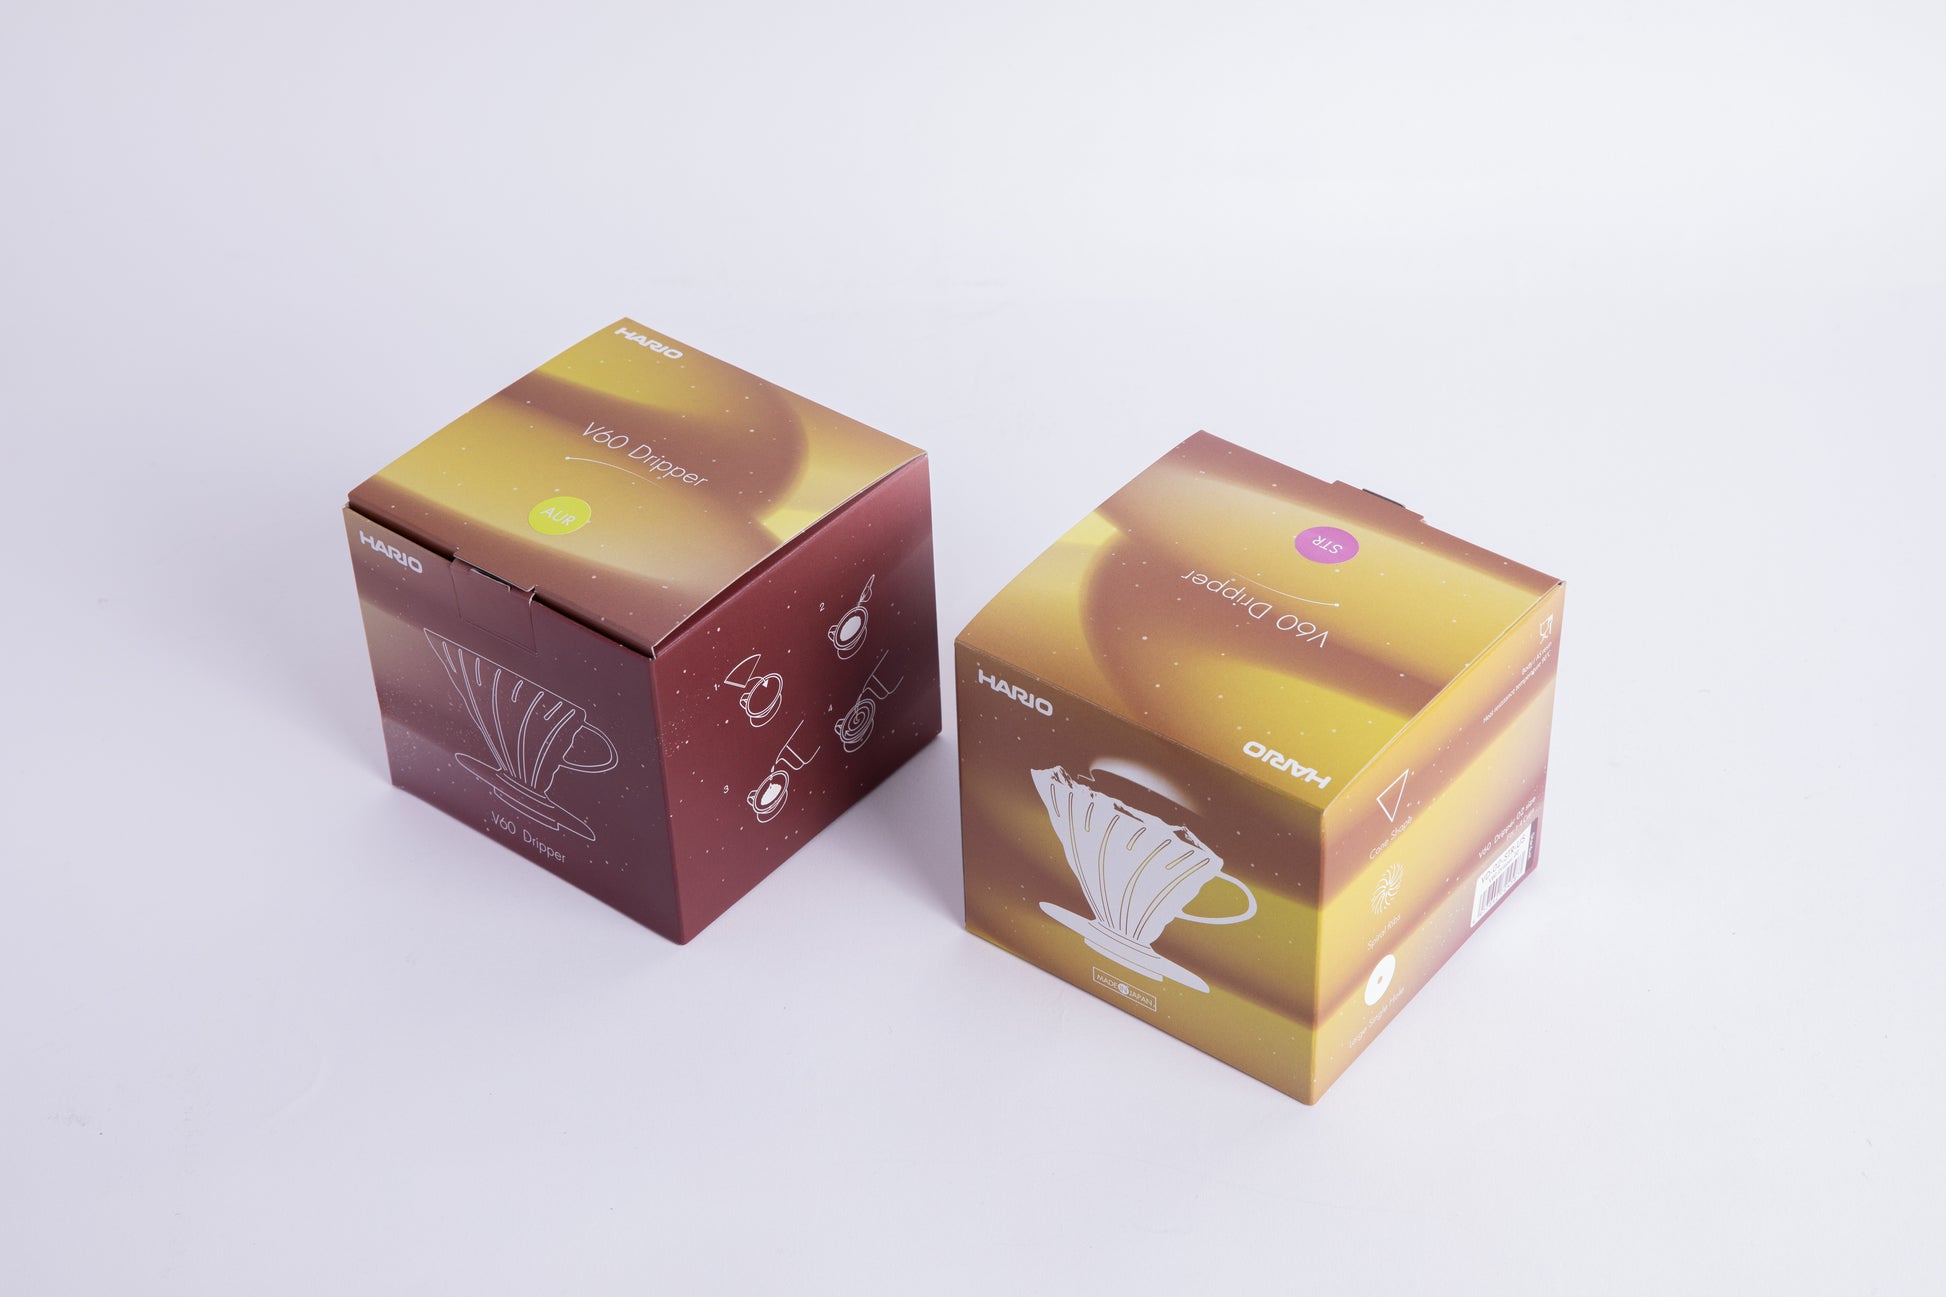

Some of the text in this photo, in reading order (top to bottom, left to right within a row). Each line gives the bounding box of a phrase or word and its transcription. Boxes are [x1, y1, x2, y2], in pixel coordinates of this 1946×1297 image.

[614, 327, 683, 359] HARIO
[582, 421, 709, 487] V60 Dripper
[540, 507, 577, 527] AUR
[359, 529, 423, 574] HARIO
[1312, 535, 1343, 554] STR
[1180, 570, 1329, 648] V60 Dripper
[978, 669, 1053, 717] HARIO
[1243, 741, 1332, 789] HARIO
[491, 810, 566, 863] V60 Dripper
[1369, 839, 1389, 860] Cone
[1096, 974, 1118, 989] MADE
[1128, 990, 1153, 1007] JAPAN
